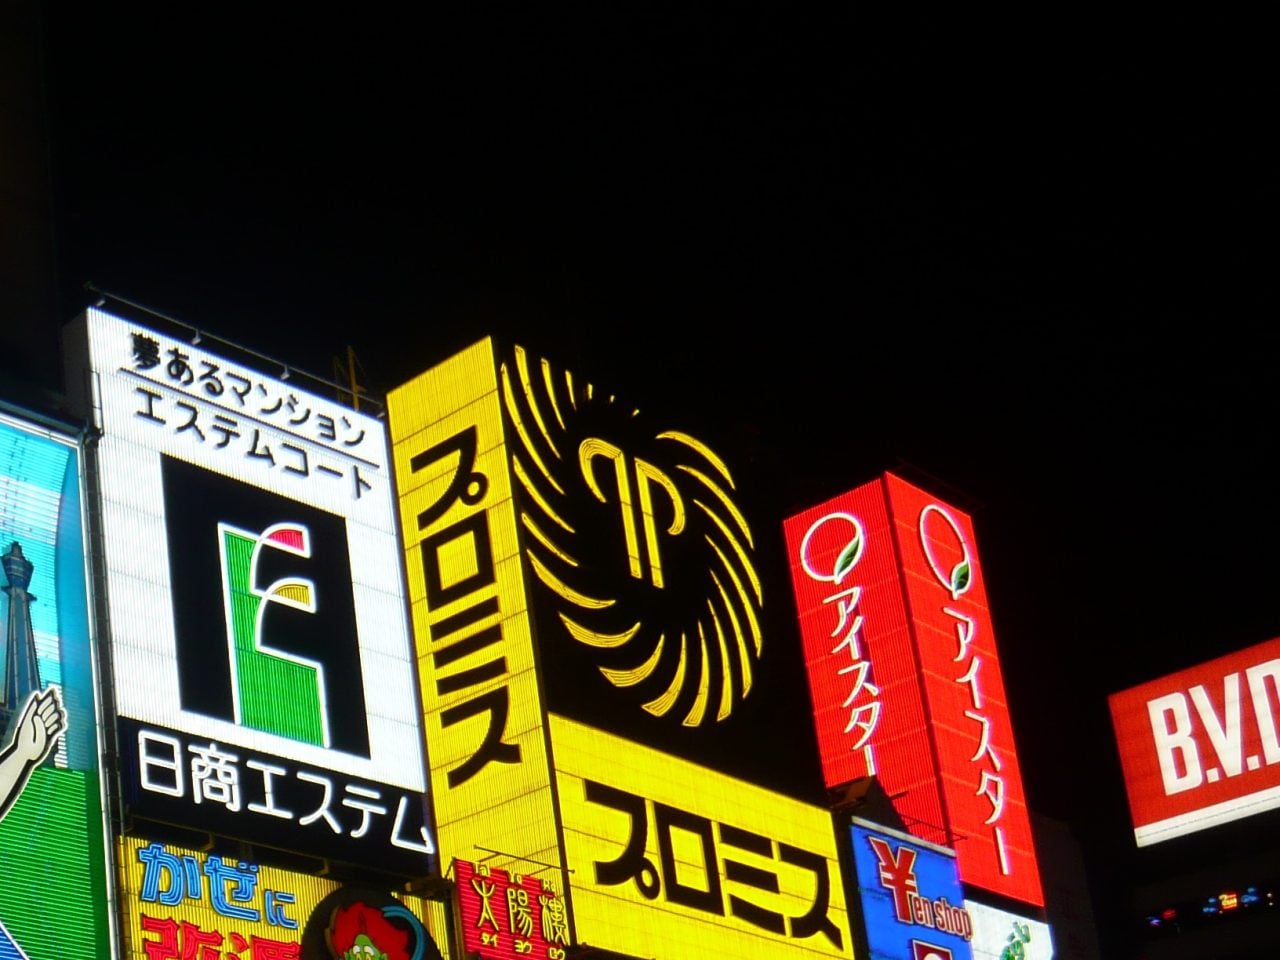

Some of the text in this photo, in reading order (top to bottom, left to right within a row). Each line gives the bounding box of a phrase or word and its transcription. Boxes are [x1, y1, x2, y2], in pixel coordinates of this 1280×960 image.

[129, 331, 366, 447] 夢あるマンション
[135, 385, 373, 500] エステムコート
[410, 424, 521, 790] プロミス
[822, 585, 879, 777] アイスター
[137, 728, 435, 854] 日商エステム
[943, 606, 1010, 876] アイスター
[138, 843, 298, 929] かぜに
[583, 777, 844, 952] プロミス
